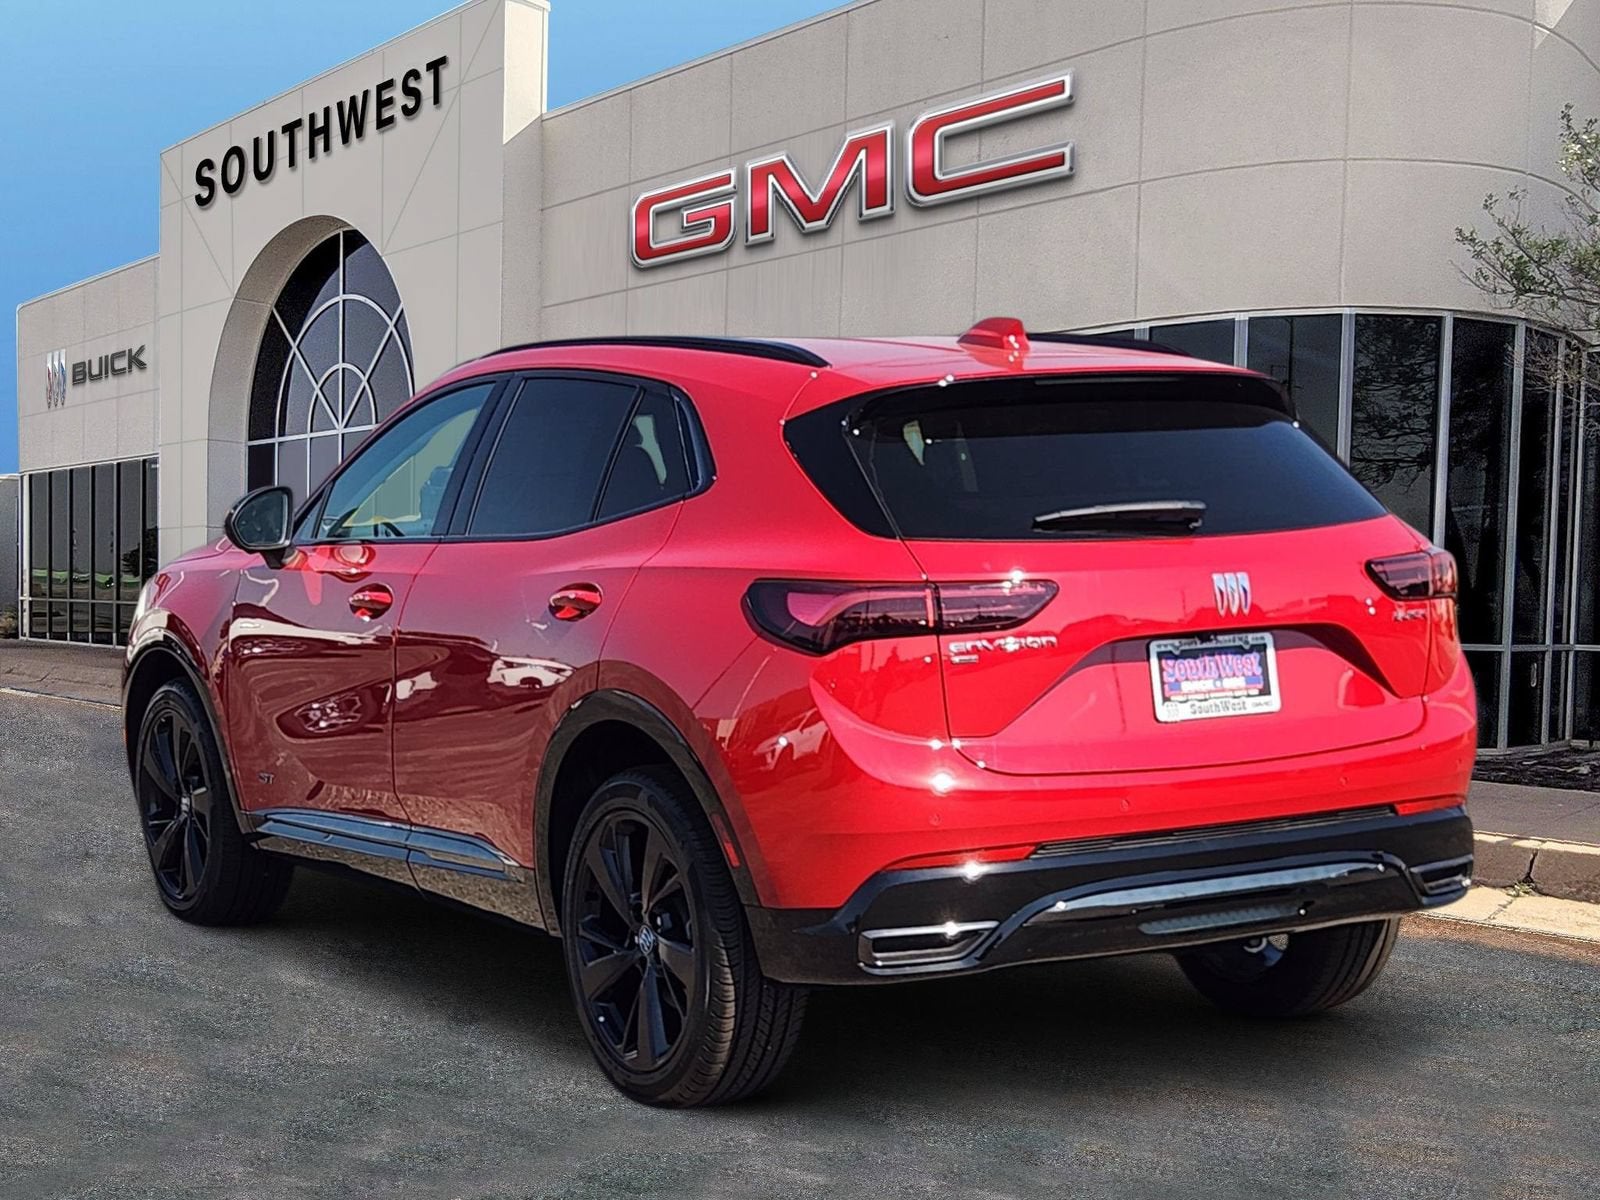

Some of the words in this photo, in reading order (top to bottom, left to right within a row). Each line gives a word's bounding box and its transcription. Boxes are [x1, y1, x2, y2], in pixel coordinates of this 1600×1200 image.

[195, 55, 448, 208] SOUTHWEST
[631, 69, 1075, 268] GMC
[72, 344, 147, 385] BUICK
